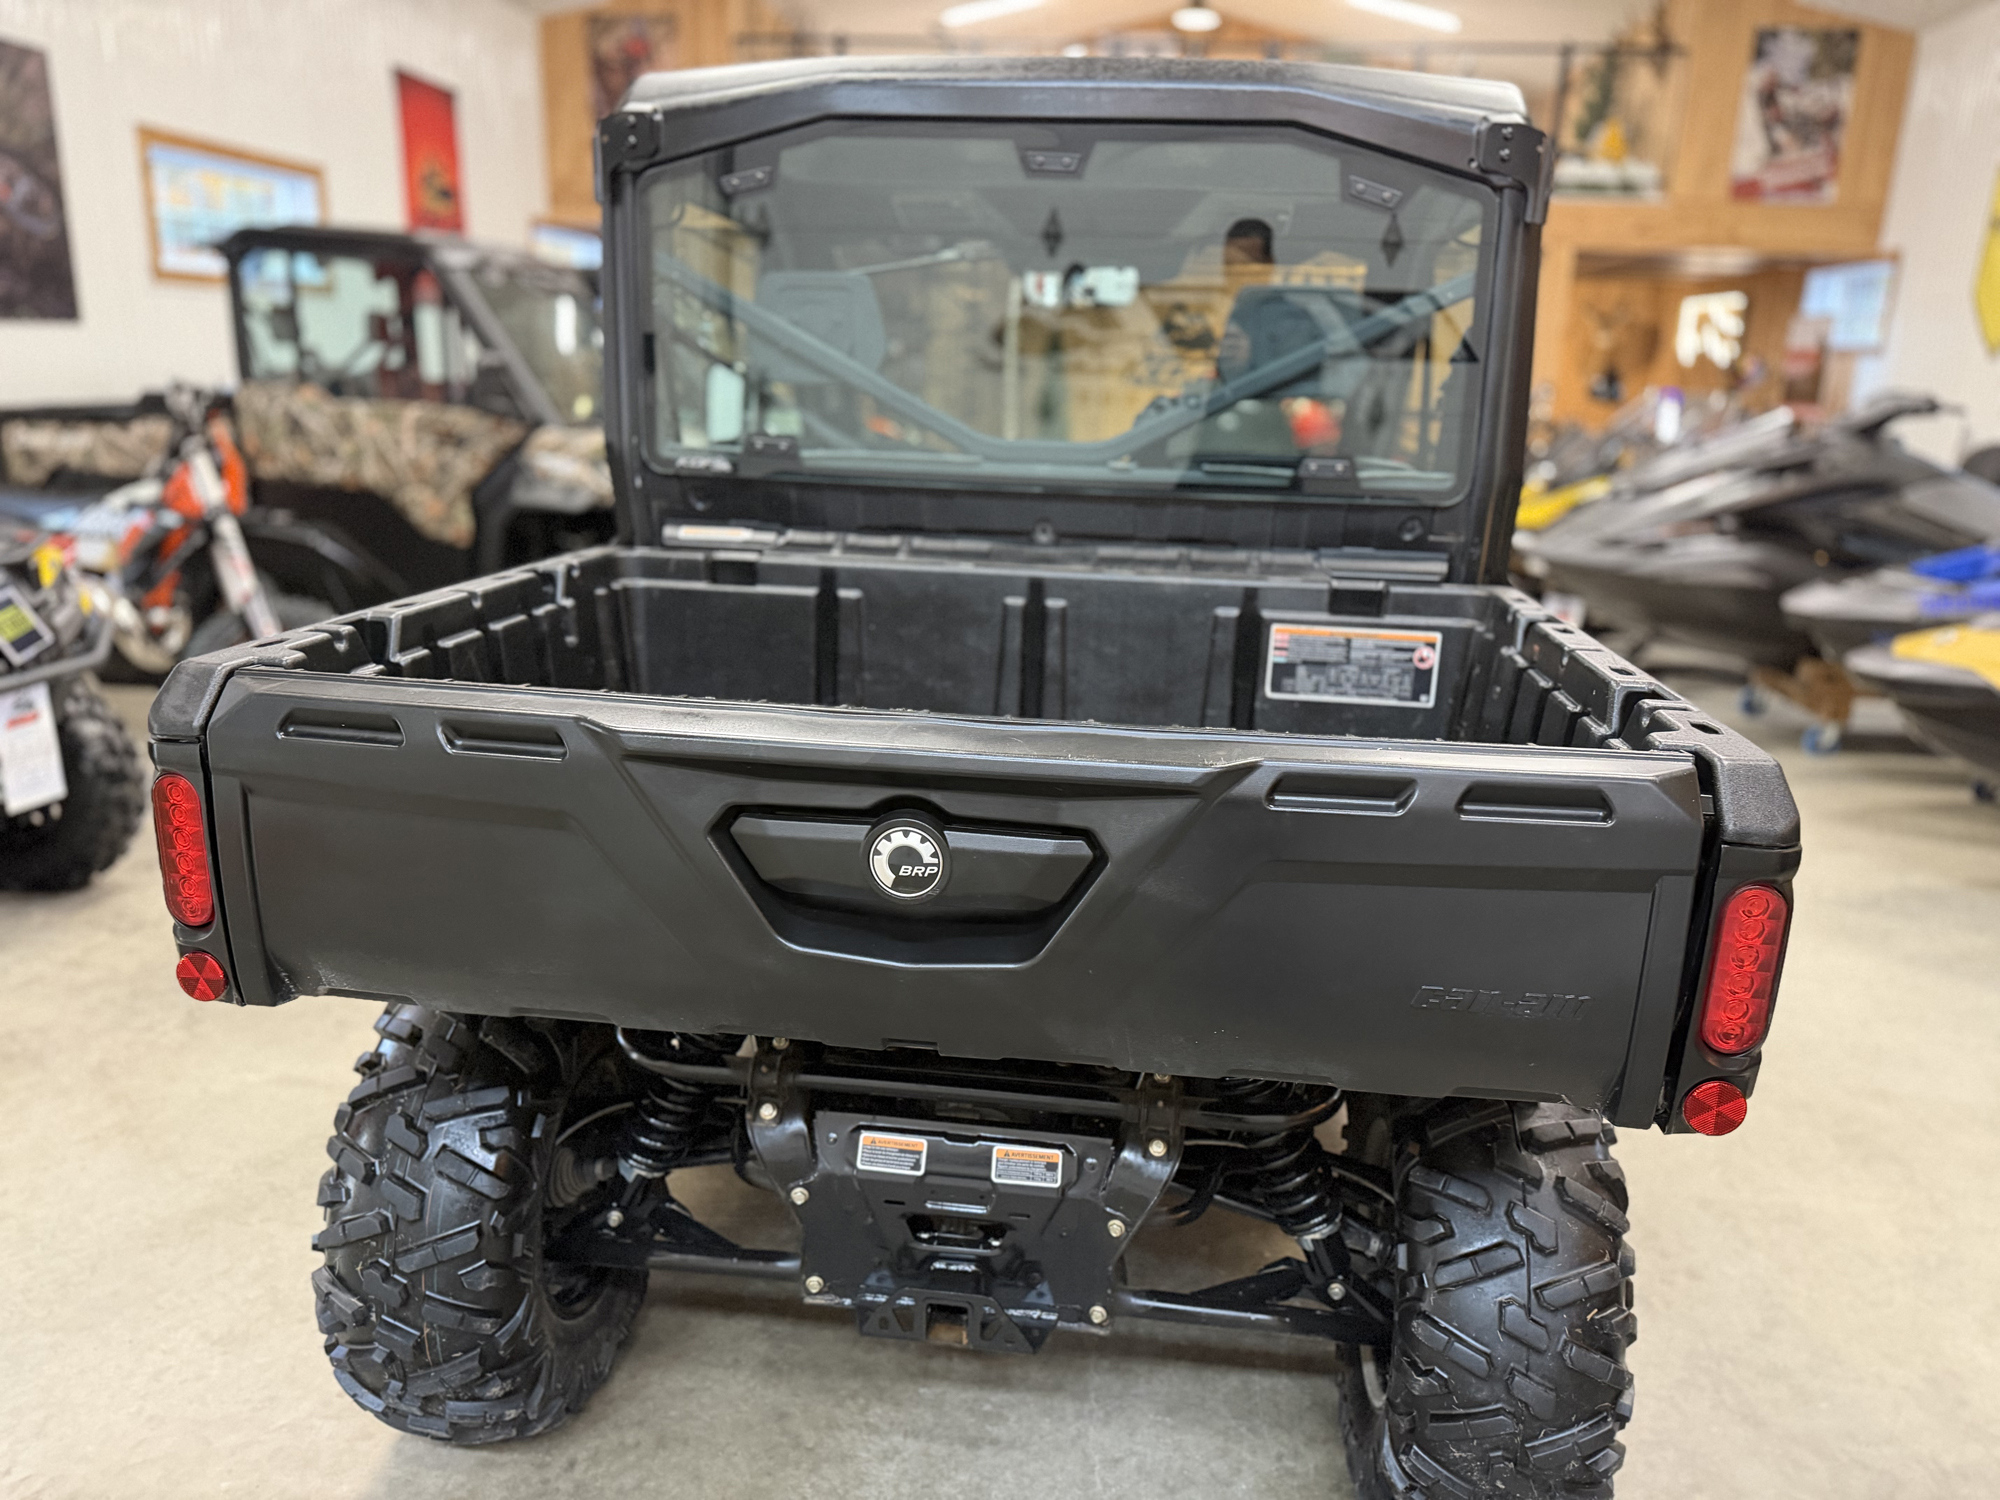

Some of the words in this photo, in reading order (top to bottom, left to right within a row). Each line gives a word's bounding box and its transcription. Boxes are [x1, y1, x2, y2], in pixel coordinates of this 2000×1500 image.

[898, 865, 938, 878] BRP
[877, 1139, 919, 1148] AVERTISSEMENT
[1010, 1151, 1054, 1160] AVERTISSEMENT
